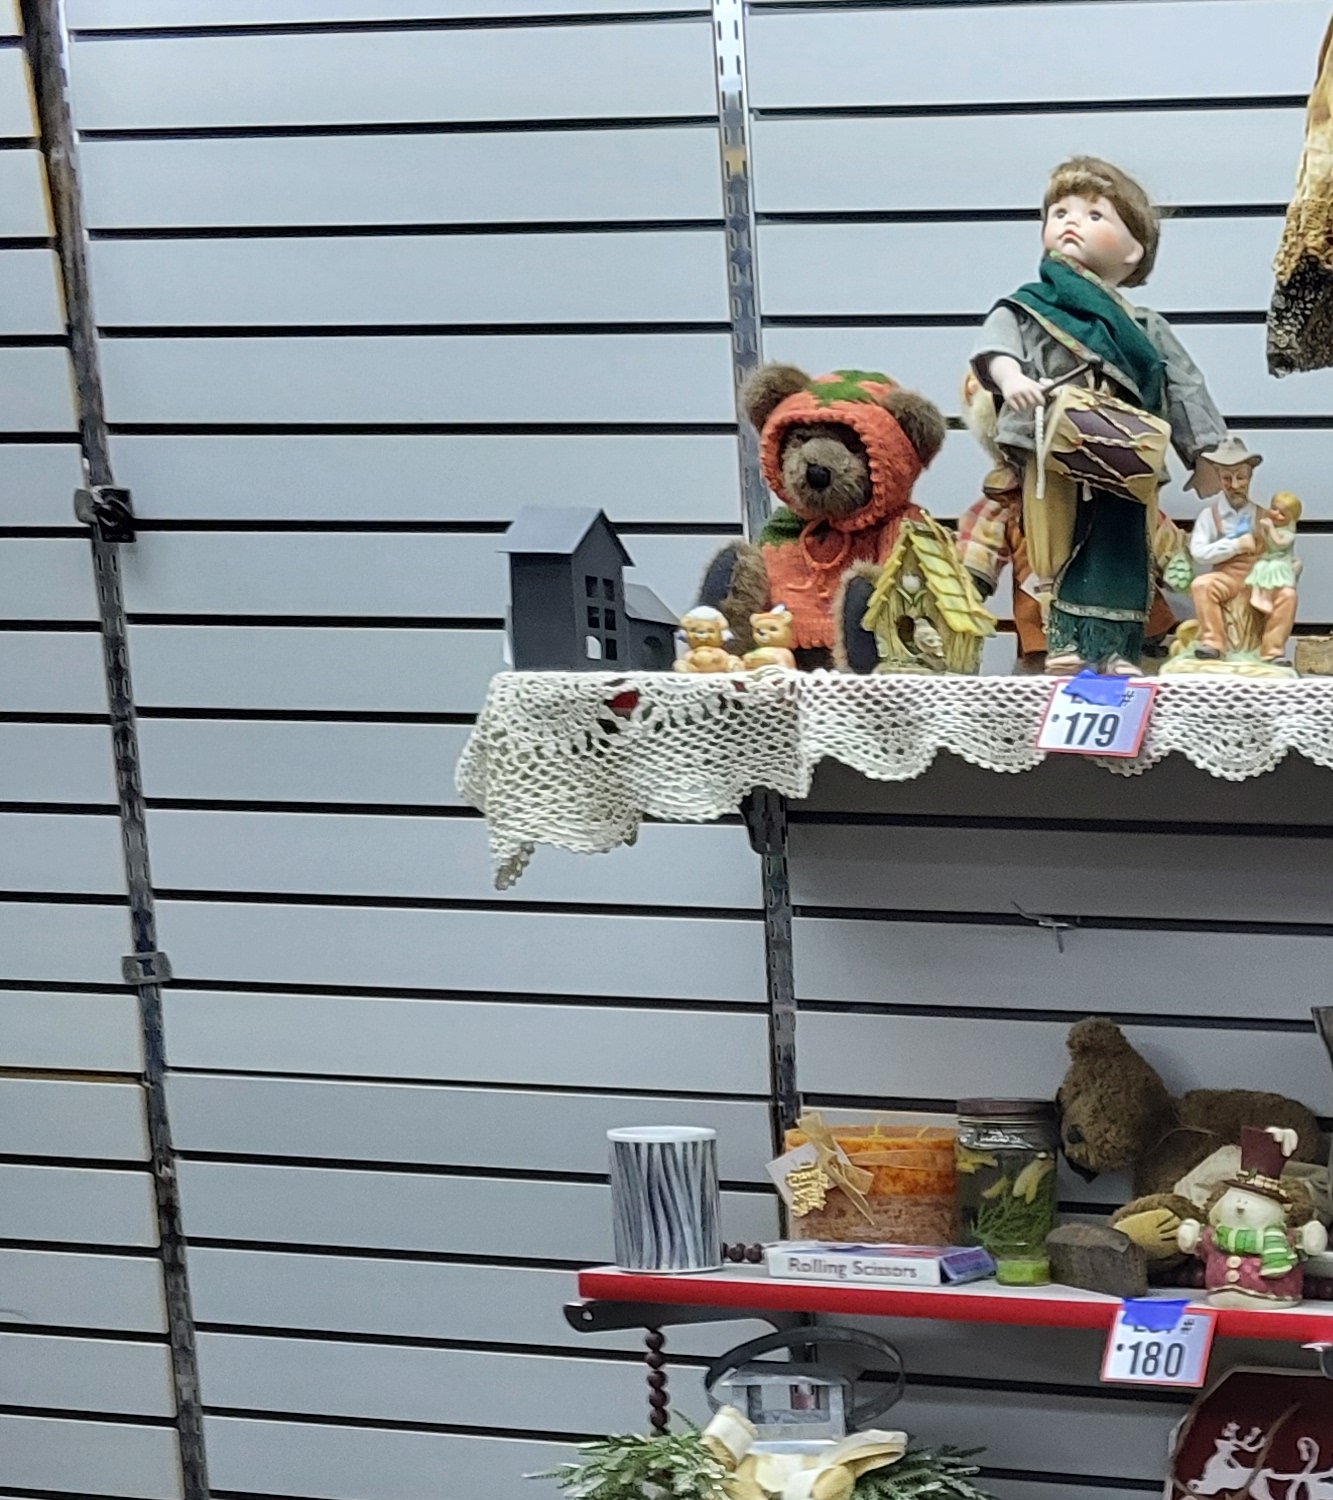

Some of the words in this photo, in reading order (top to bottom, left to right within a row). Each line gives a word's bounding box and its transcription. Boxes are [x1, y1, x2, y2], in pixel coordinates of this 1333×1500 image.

[1065, 712, 1120, 747] 179
[788, 1258, 847, 1278] Rolling
[852, 1260, 917, 1279] Scissors
[1128, 1341, 1185, 1377] 180
